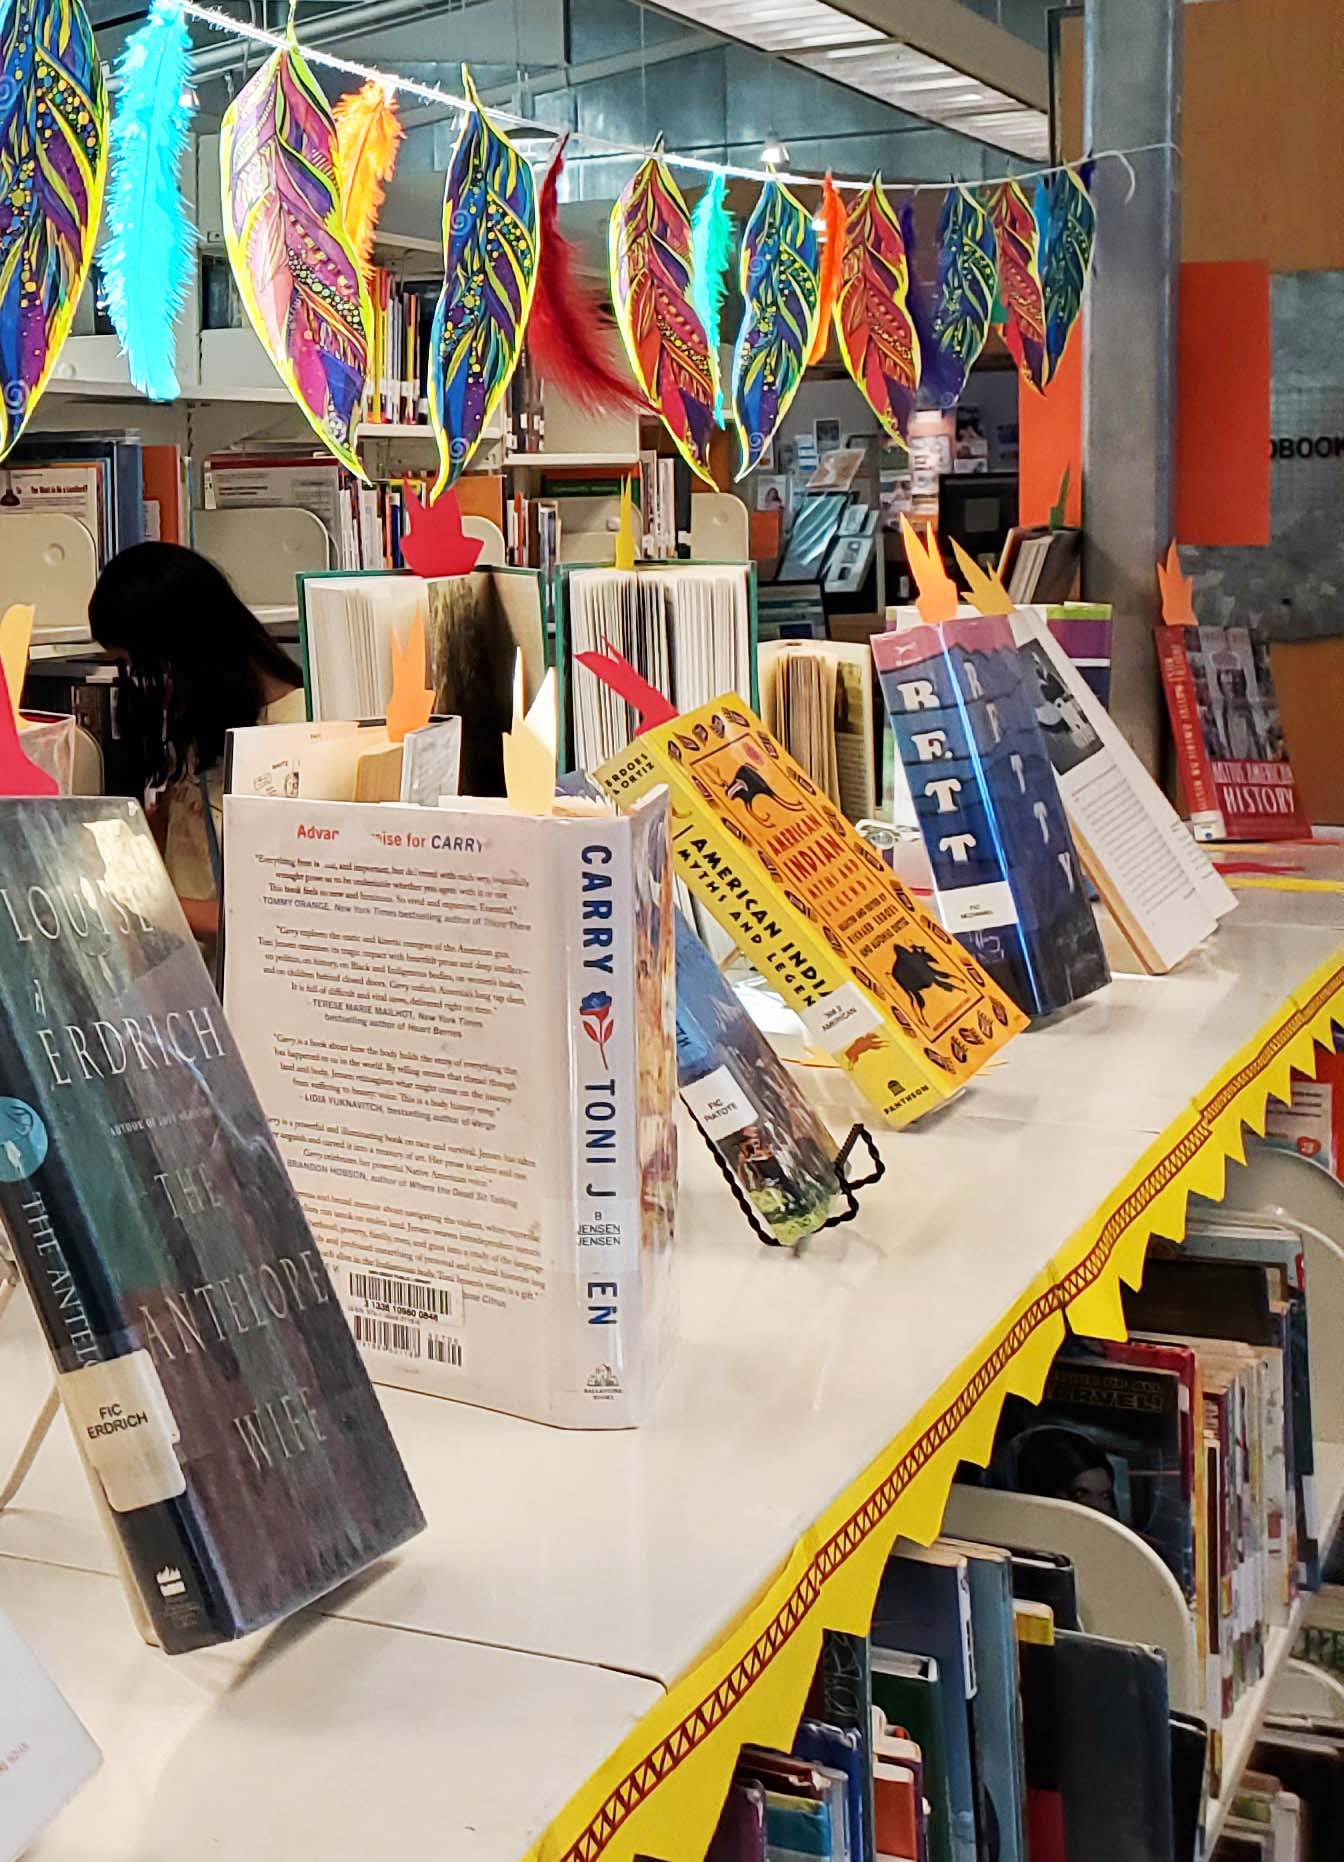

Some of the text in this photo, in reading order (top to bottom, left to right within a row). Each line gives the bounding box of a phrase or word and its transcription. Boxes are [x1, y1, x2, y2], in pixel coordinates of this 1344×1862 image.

[604, 752, 649, 788] ERDOES
[1212, 761, 1243, 784] NATIVE
[1222, 785, 1296, 814] HISTORY
[766, 813, 824, 858] AMERICAN
[782, 832, 844, 884] INDIAN
[806, 858, 861, 900] MYTHS AND
[581, 844, 615, 975] CARRY
[689, 837, 784, 939] AMERICAN
[819, 874, 877, 918] LEGENDS
[677, 847, 817, 1008] MYTHS AND LEGEN
[312, 998, 344, 1011] TERESE
[345, 1002, 373, 1014] MARIE
[418, 1012, 436, 1022] New
[820, 1007, 858, 1033] AMERICAN
[36, 1006, 228, 1087] ERDRICH
[584, 1078, 617, 1198] TONI J
[152, 1162, 225, 1219] THE
[21, 1195, 64, 1257] THE
[577, 1223, 621, 1236] JENSEN
[594, 1211, 603, 1222] B
[577, 1235, 622, 1247] JENSEN
[136, 1249, 331, 1361] ANTELOPE
[587, 1281, 619, 1327] EN
[86, 1411, 150, 1440] ERDRICH
[98, 1402, 123, 1419] FIC
[231, 1387, 328, 1472] WIFE
